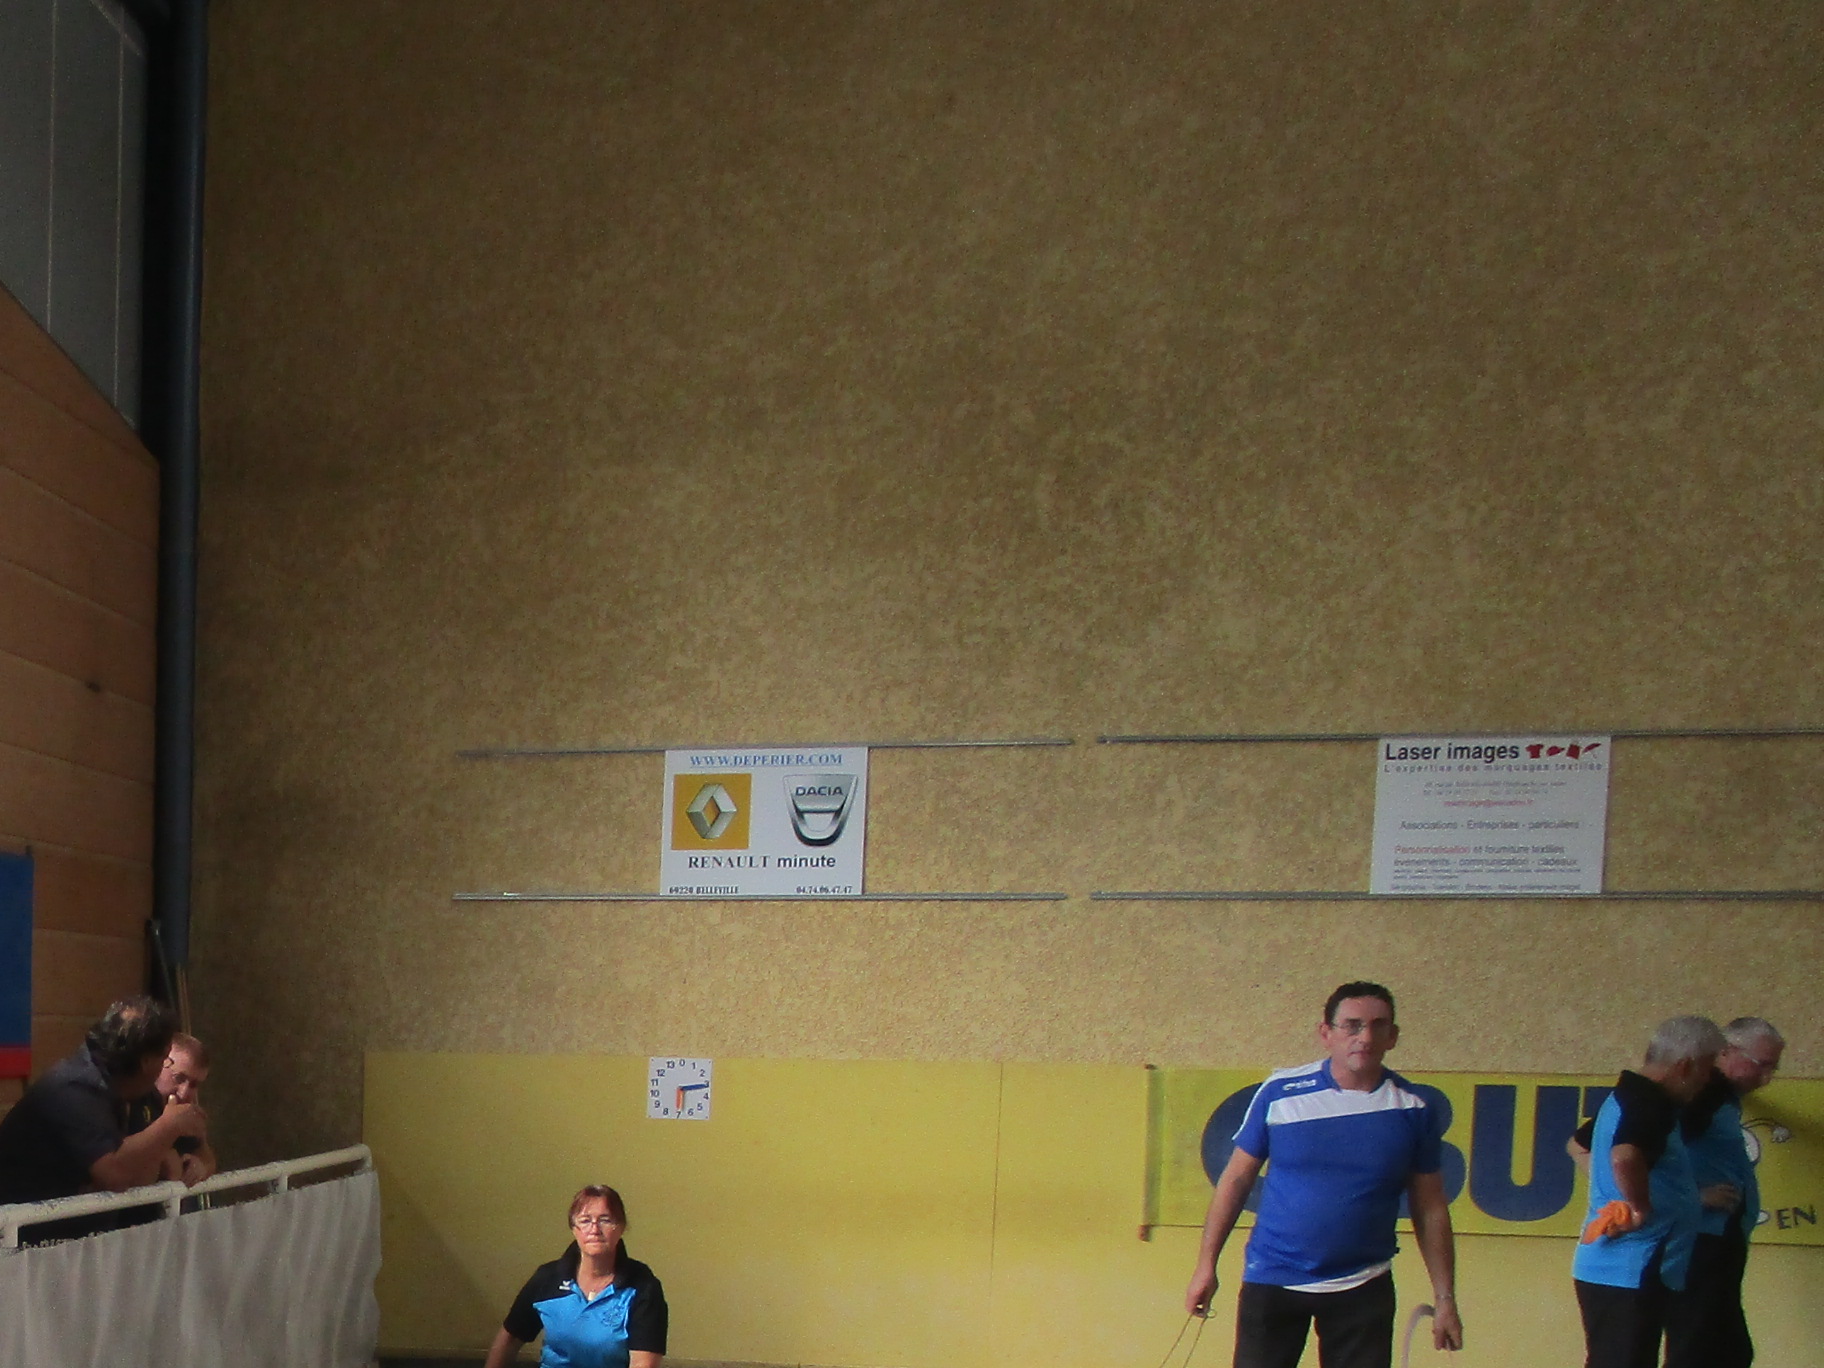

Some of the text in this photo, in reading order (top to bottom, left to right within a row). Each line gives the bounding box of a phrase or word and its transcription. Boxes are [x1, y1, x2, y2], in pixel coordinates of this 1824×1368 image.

[1386, 743, 1520, 763] Laser images
[690, 754, 842, 766] WWW.DEPERIER.COM
[1457, 764, 1478, 772] des
[795, 786, 843, 796] DACIA
[688, 854, 836, 869] RENAULT minute
[696, 886, 740, 894] BELLEVILLE
[667, 1061, 675, 1069] 13
[679, 1059, 685, 1067] 0
[657, 1069, 665, 1077] 12
[699, 1069, 705, 1077] 2
[697, 1103, 703, 1111] 5
[676, 1111, 681, 1119] 7
[1776, 1204, 1817, 1230] EN
